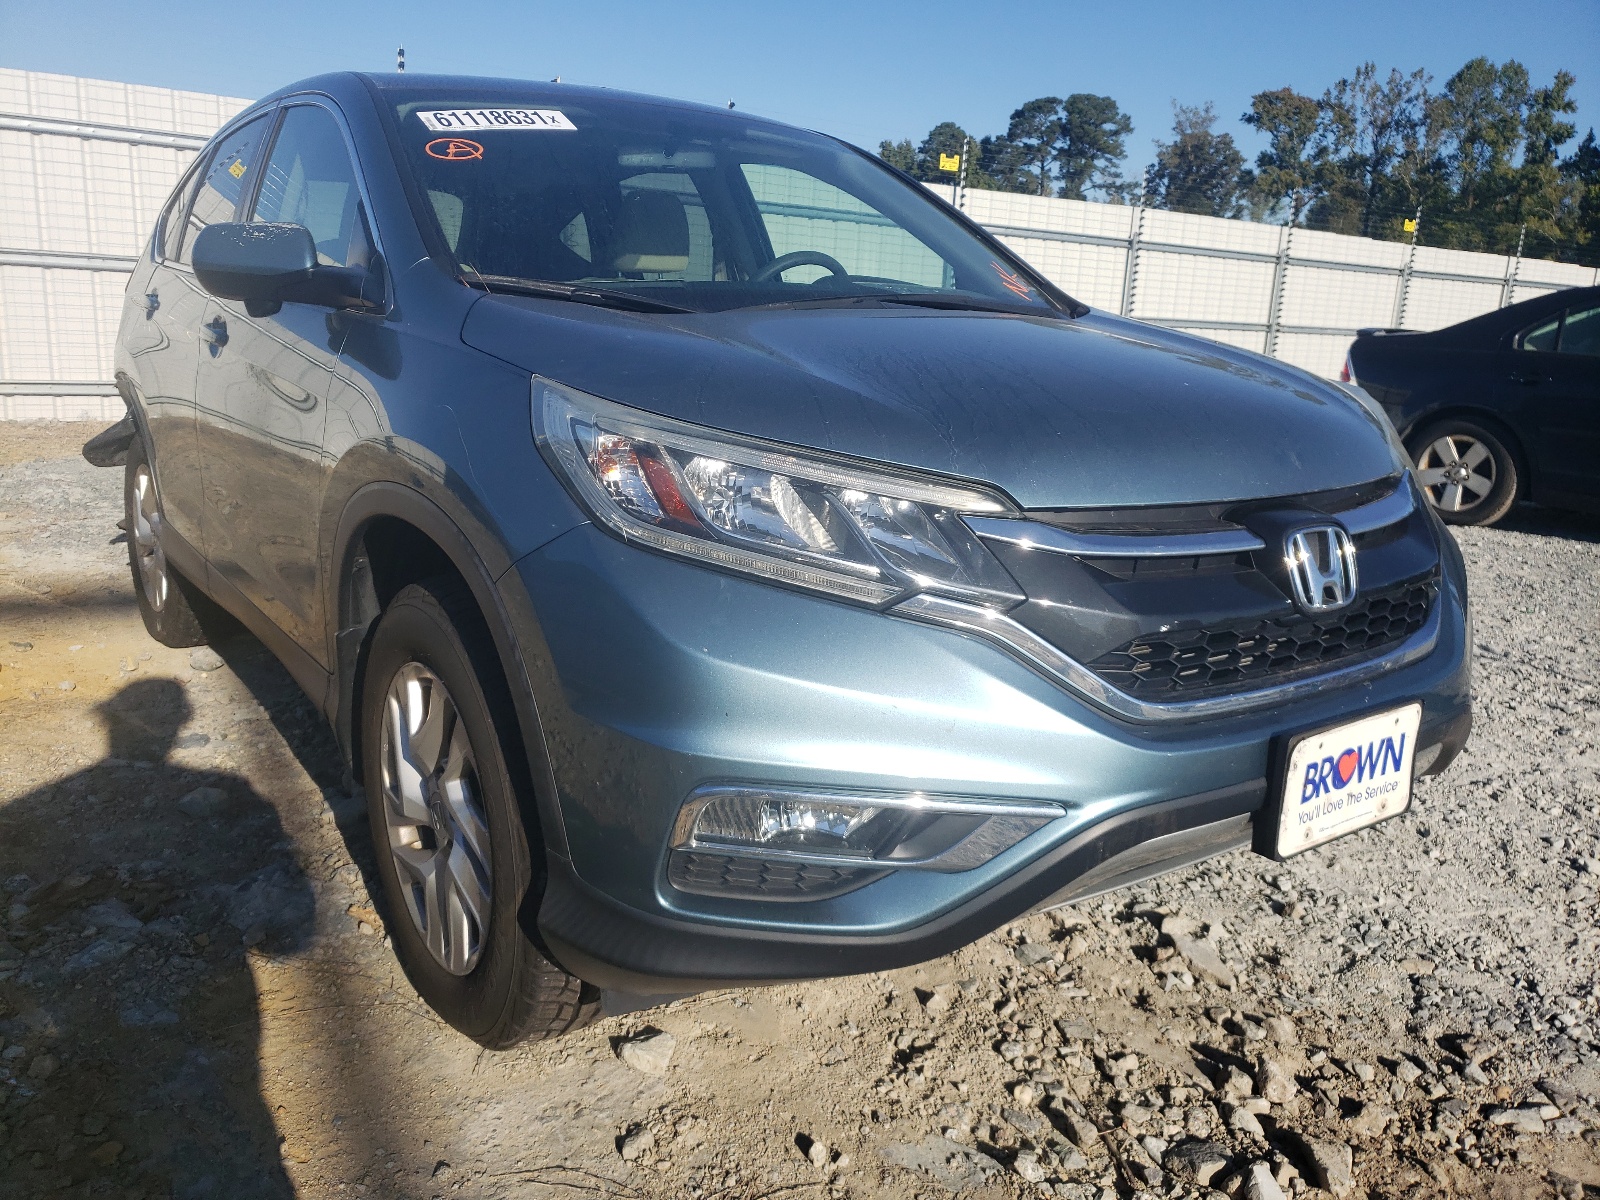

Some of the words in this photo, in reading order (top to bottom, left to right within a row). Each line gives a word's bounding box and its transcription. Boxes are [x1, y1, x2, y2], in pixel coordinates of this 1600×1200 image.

[1300, 732, 1406, 806] BROWN
[1298, 804, 1321, 826] You'll
[1322, 798, 1344, 816] Love
[1346, 791, 1363, 807] The
[1364, 780, 1398, 800] Service
